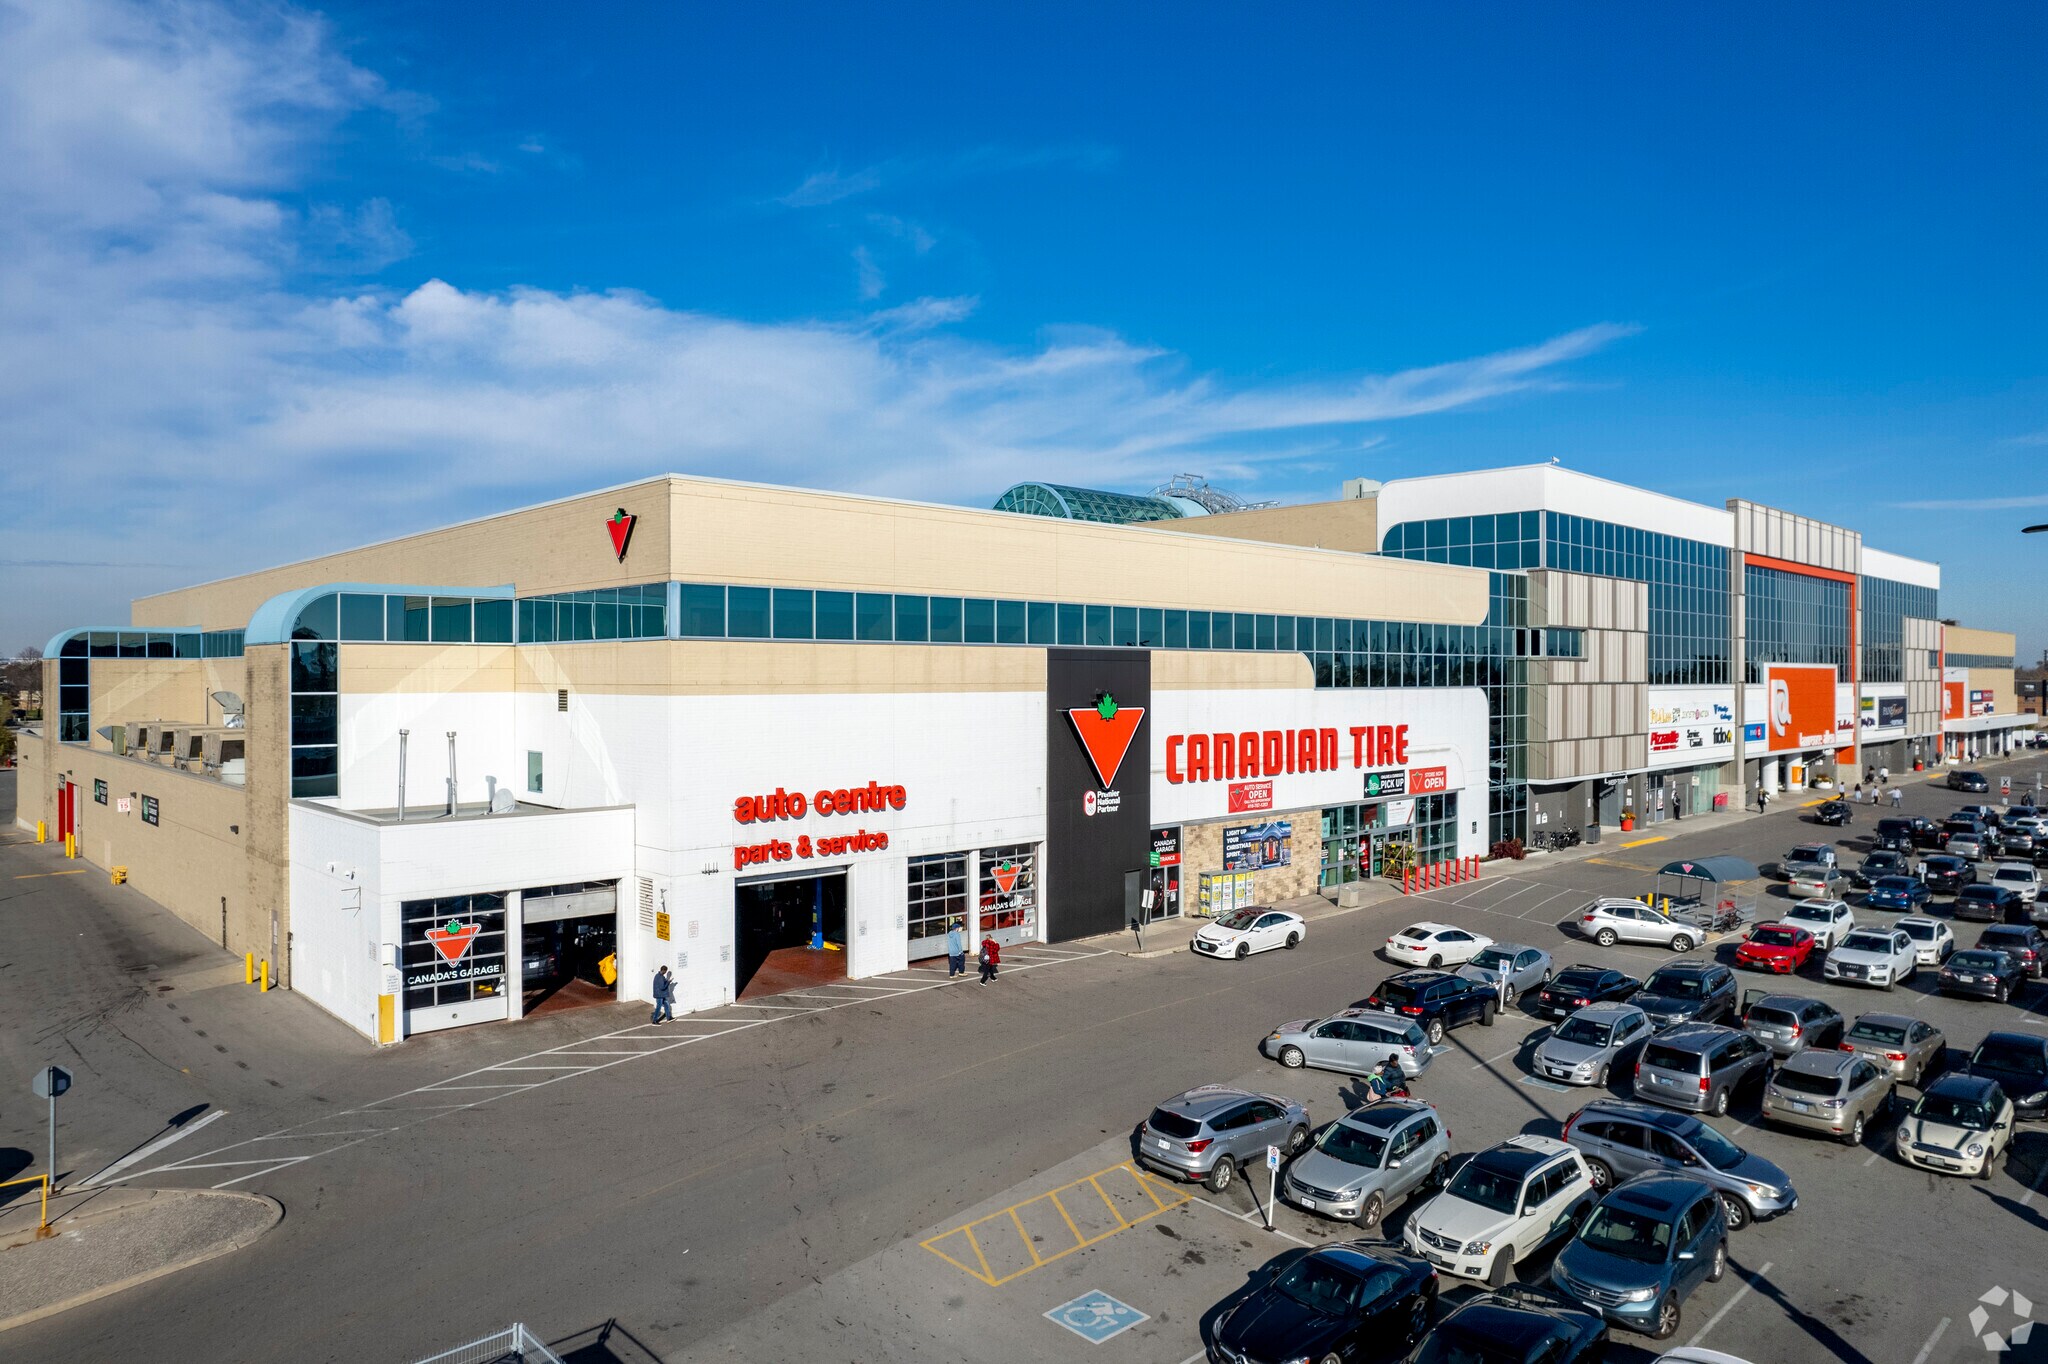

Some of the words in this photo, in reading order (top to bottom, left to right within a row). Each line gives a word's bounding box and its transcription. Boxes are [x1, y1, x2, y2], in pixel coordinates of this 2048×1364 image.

[1166, 728, 1338, 784] CANADIAN
[1350, 724, 1409, 769] TIRE
[1381, 780, 1394, 789] PICK
[1396, 778, 1404, 787] UP
[1424, 777, 1444, 789] OPEN
[1097, 790, 1120, 798] Premier
[1248, 790, 1267, 799] OPEN
[734, 788, 807, 825] auto
[814, 781, 907, 817] centre
[1097, 797, 1120, 806] National
[1097, 805, 1118, 813] Partner
[1153, 839, 1176, 847] CANADA'S
[1226, 842, 1251, 850] CHRISTMAS
[734, 839, 792, 871] parts
[796, 835, 814, 858] &
[816, 829, 888, 858] service
[1156, 845, 1175, 853] GARAGE
[980, 901, 1008, 912] CANADA'S
[1009, 898, 1032, 908] GARAGE
[407, 972, 457, 985] CANADA'S
[460, 964, 499, 978] GARAGE
